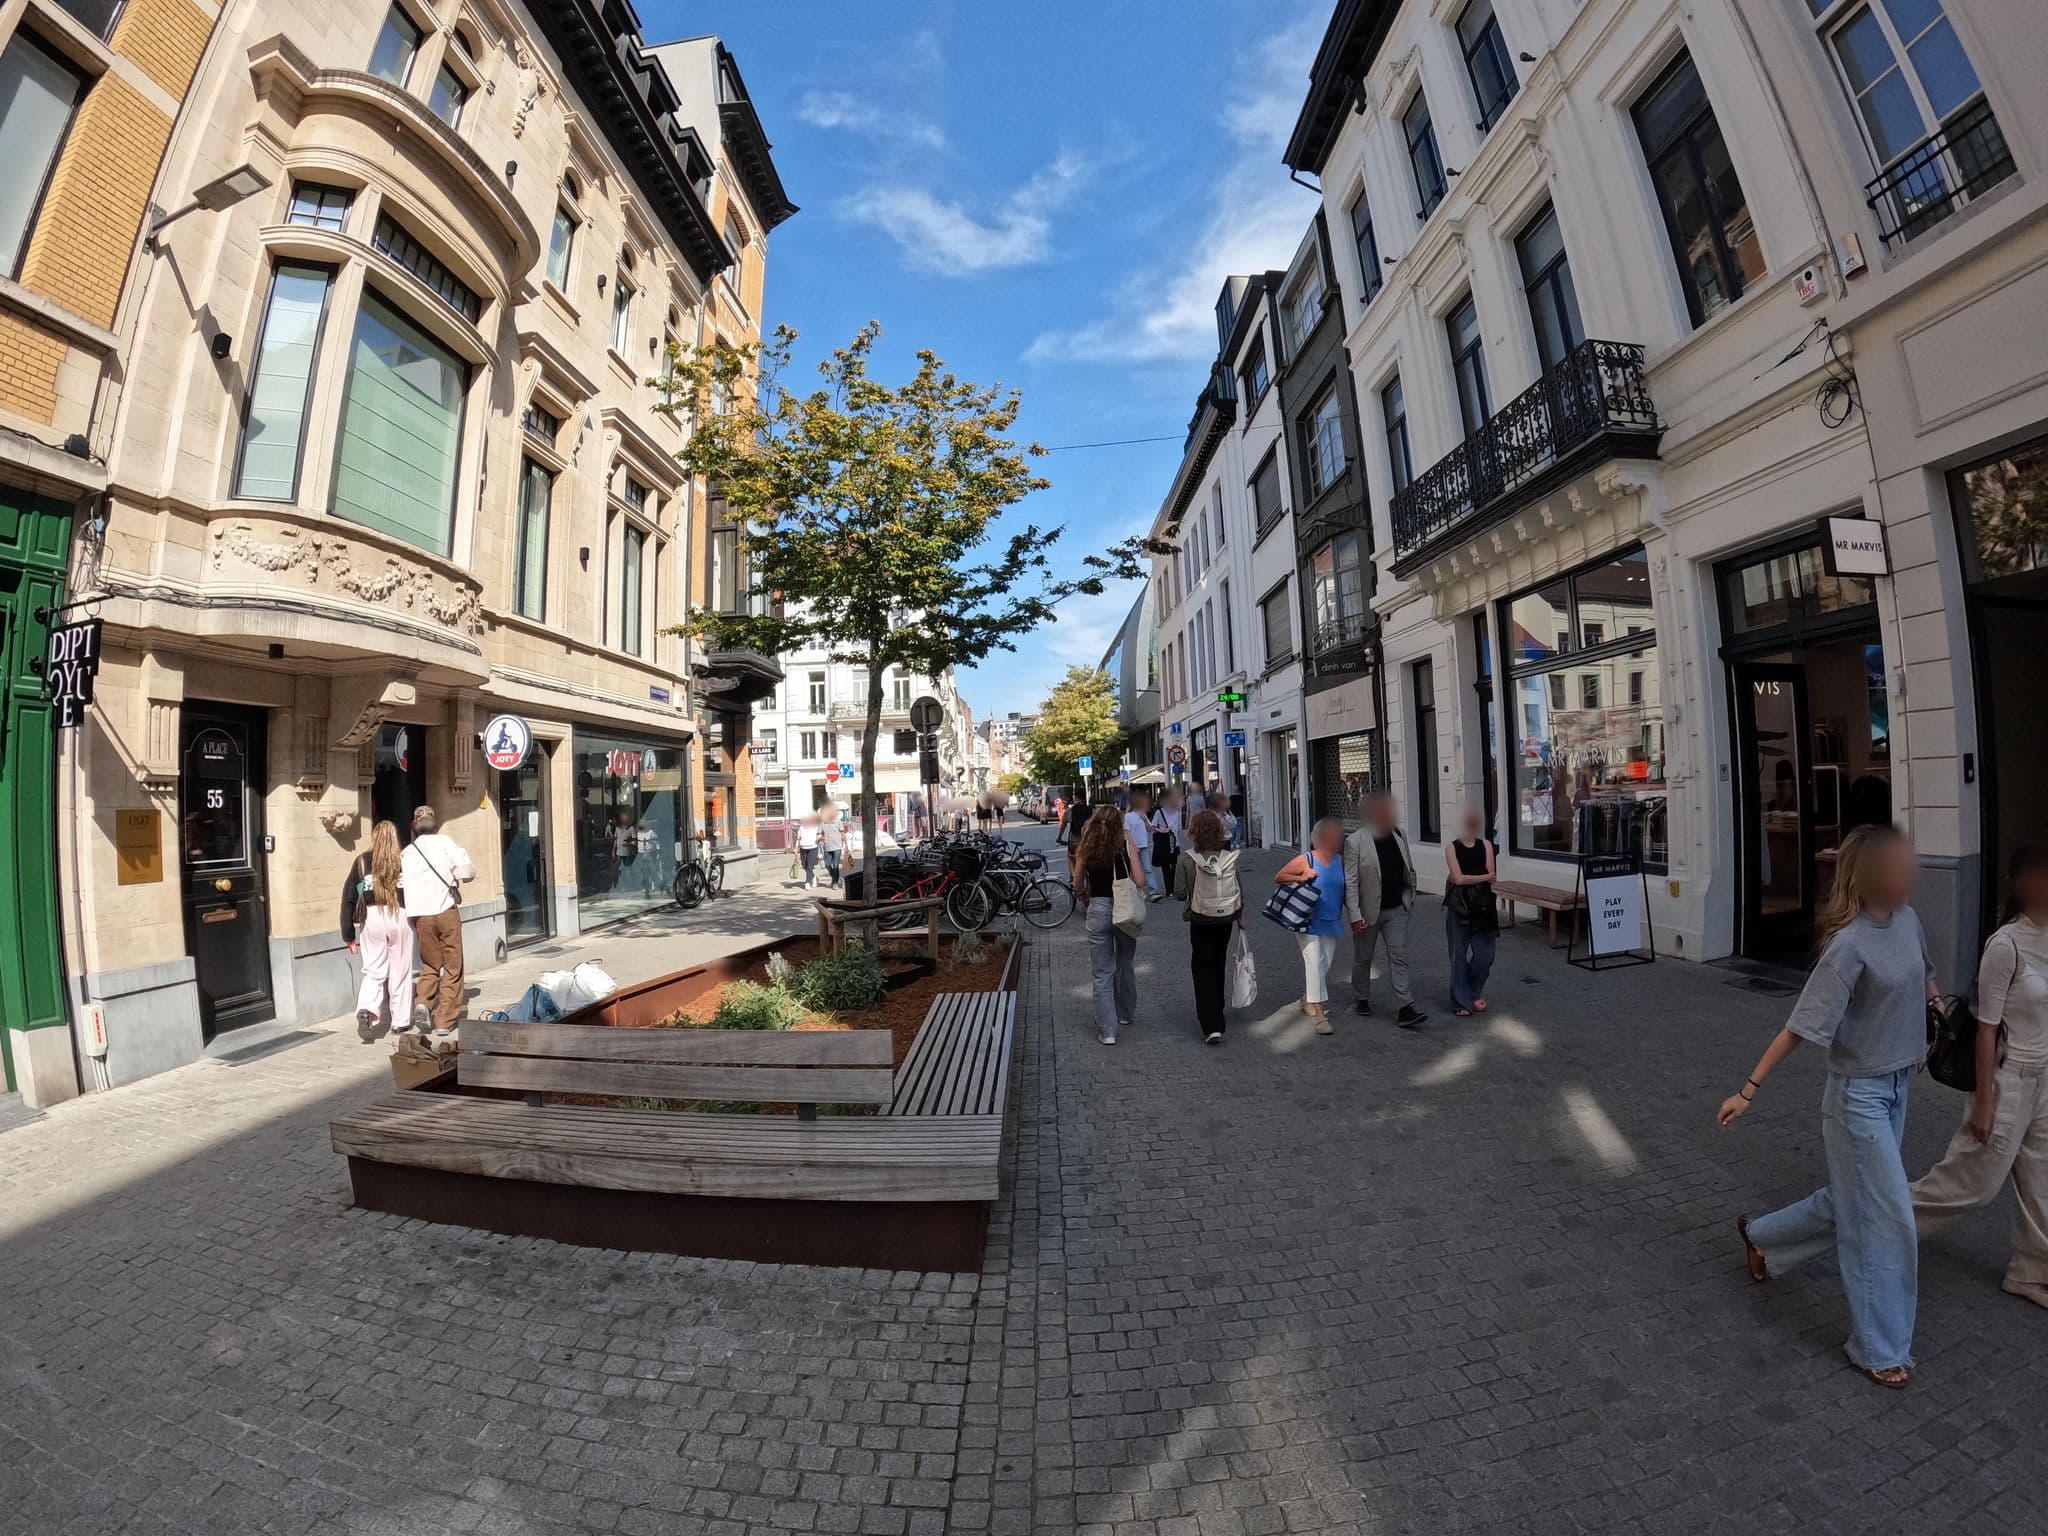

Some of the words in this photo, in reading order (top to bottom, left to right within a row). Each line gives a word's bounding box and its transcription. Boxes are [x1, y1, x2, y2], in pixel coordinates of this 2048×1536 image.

[1835, 540, 1849, 550] MR
[1851, 541, 1883, 553] MARVIS
[50, 624, 95, 664] DIPT
[1321, 661, 1340, 672] dinh
[1753, 681, 1780, 695] VIS
[202, 742, 208, 753] A
[208, 742, 228, 754] PLACE
[605, 749, 641, 776] JOTT
[1546, 750, 1566, 767] MR
[1569, 746, 1625, 767] MARVIS
[207, 789, 223, 808] 55
[1605, 863, 1631, 872] MARVIS
[1605, 897, 1621, 906] PLAY
[1603, 909, 1624, 919] EVERY
[1608, 921, 1621, 929] DAY
